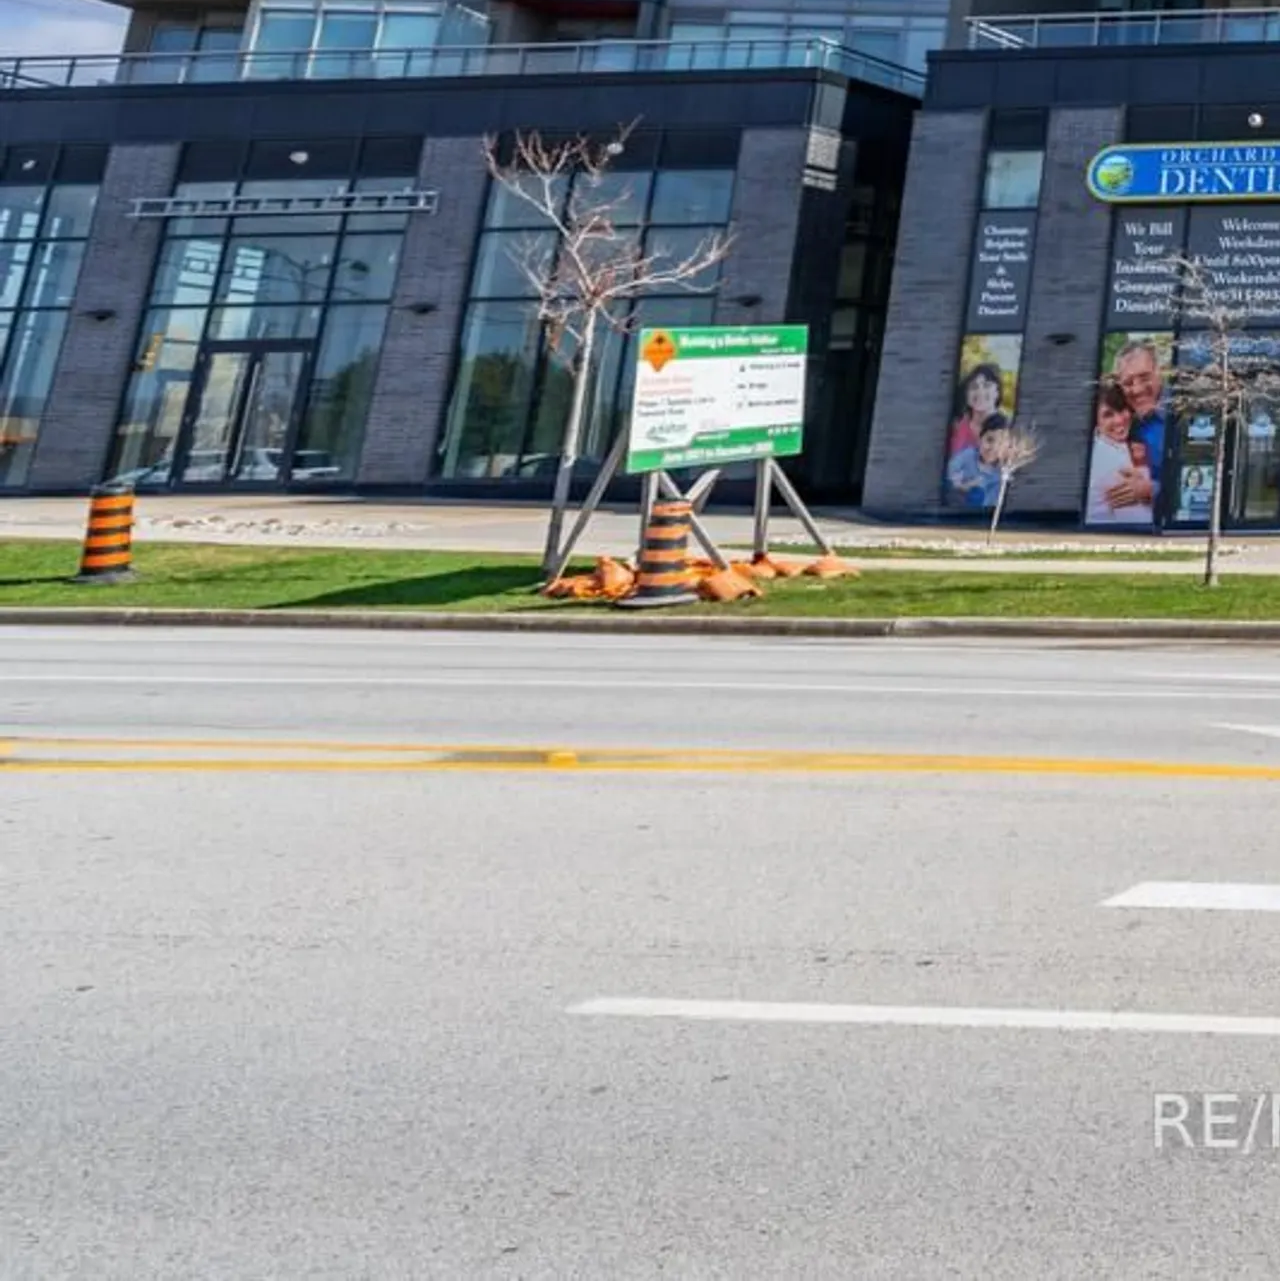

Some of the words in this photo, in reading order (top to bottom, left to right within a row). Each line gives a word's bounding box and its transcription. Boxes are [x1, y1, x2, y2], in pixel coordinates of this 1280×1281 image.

[1161, 148, 1276, 164] ORCHARD
[1149, 222, 1172, 236] Bill
[1222, 218, 1280, 231] Welcome
[1133, 241, 1165, 254] Your
